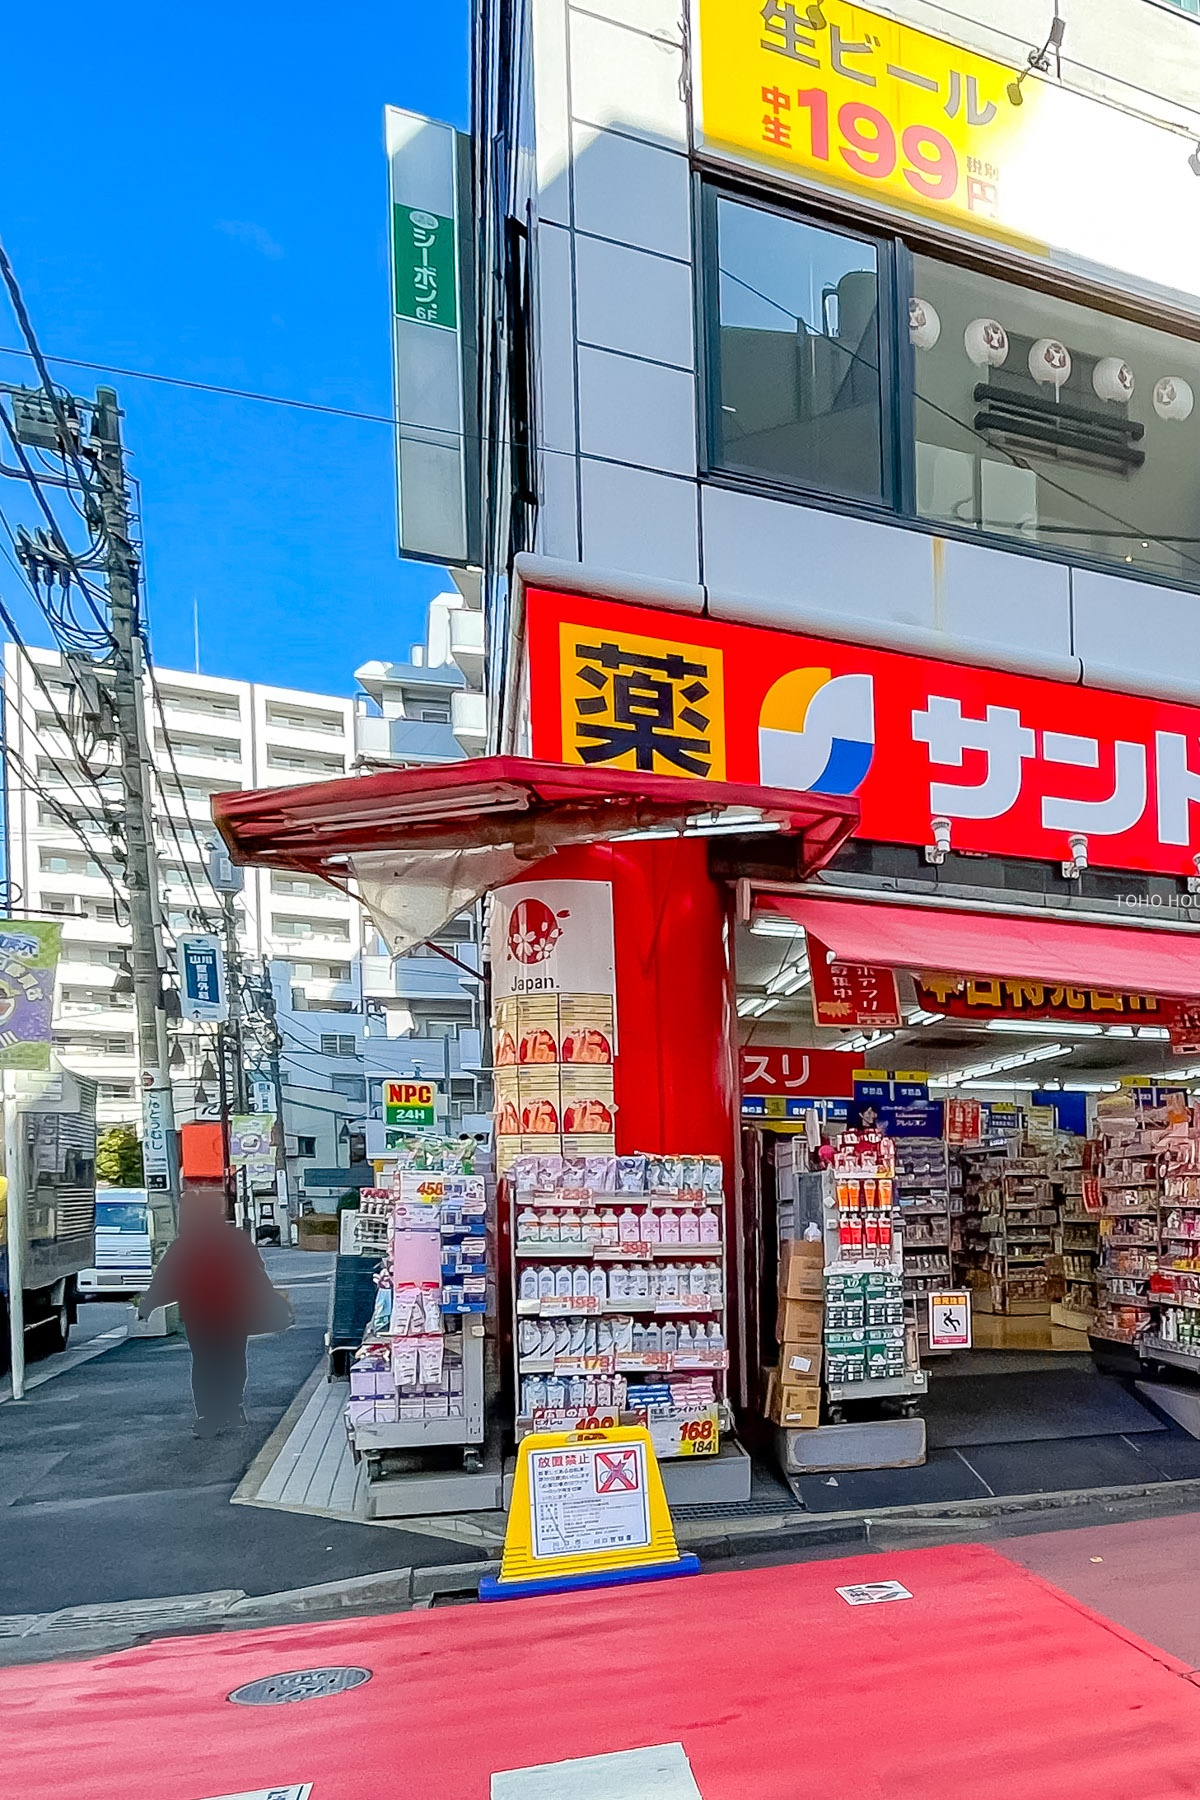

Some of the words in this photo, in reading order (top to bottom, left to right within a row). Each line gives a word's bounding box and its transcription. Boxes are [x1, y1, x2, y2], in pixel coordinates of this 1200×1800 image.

[760, 0, 998, 127] 生ビール
[761, 86, 792, 150] 中生
[797, 87, 959, 200] 199
[415, 307, 438, 321] 6F
[575, 641, 711, 778] 薬
[510, 975, 561, 994] Japan.
[742, 1053, 811, 1088] スリ
[389, 1084, 431, 1103] NPC
[396, 1109, 425, 1120] 24H
[679, 1420, 713, 1441] 168
[692, 1441, 713, 1453] 184
[538, 1453, 590, 1469] 放置禁止
